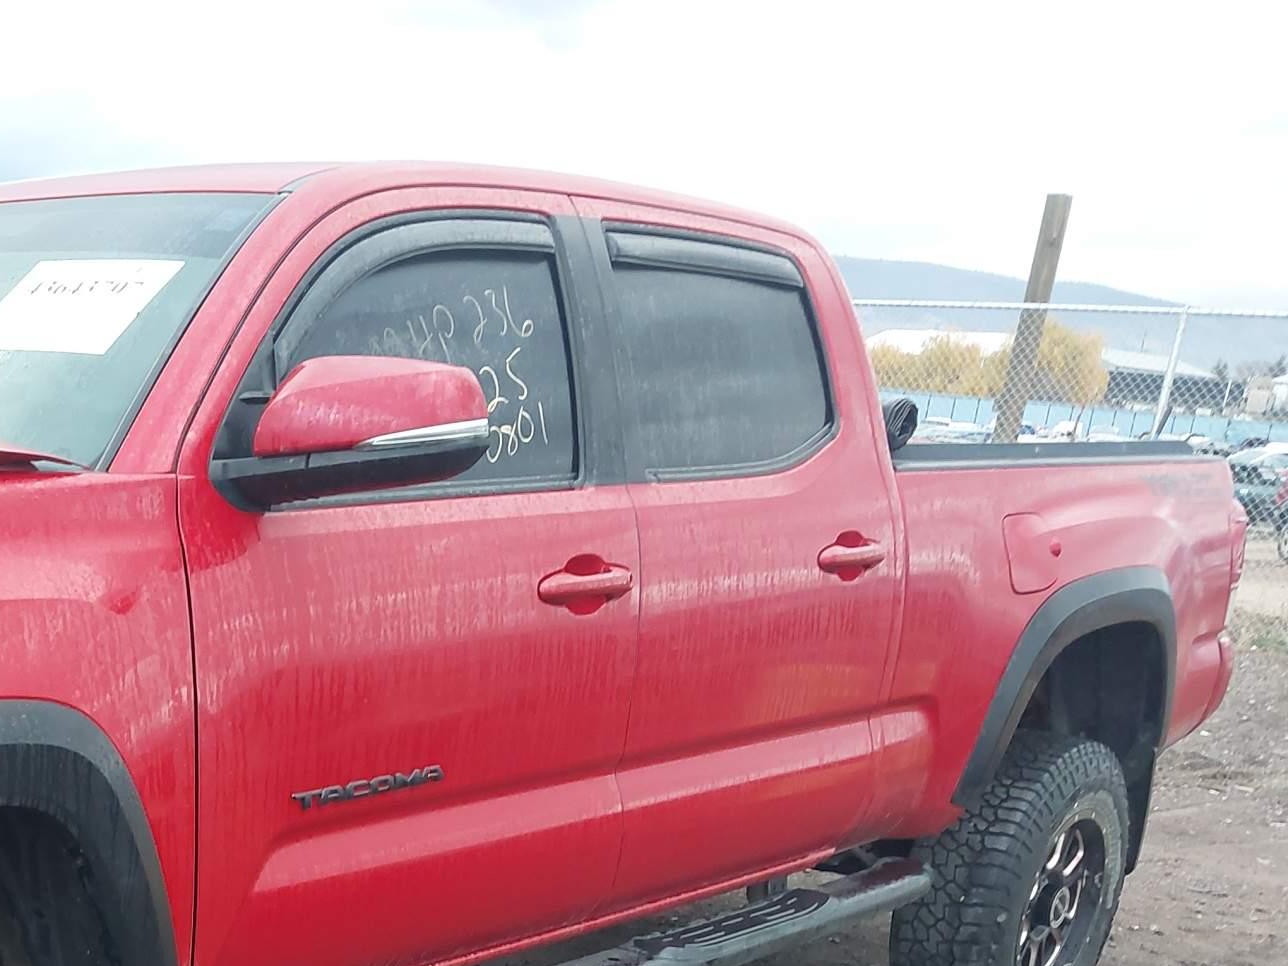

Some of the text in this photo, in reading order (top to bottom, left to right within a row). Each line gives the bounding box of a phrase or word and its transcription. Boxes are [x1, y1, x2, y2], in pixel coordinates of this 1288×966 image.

[463, 285, 534, 345] 236
[479, 346, 528, 413] 25
[290, 764, 445, 811] TACOMA
